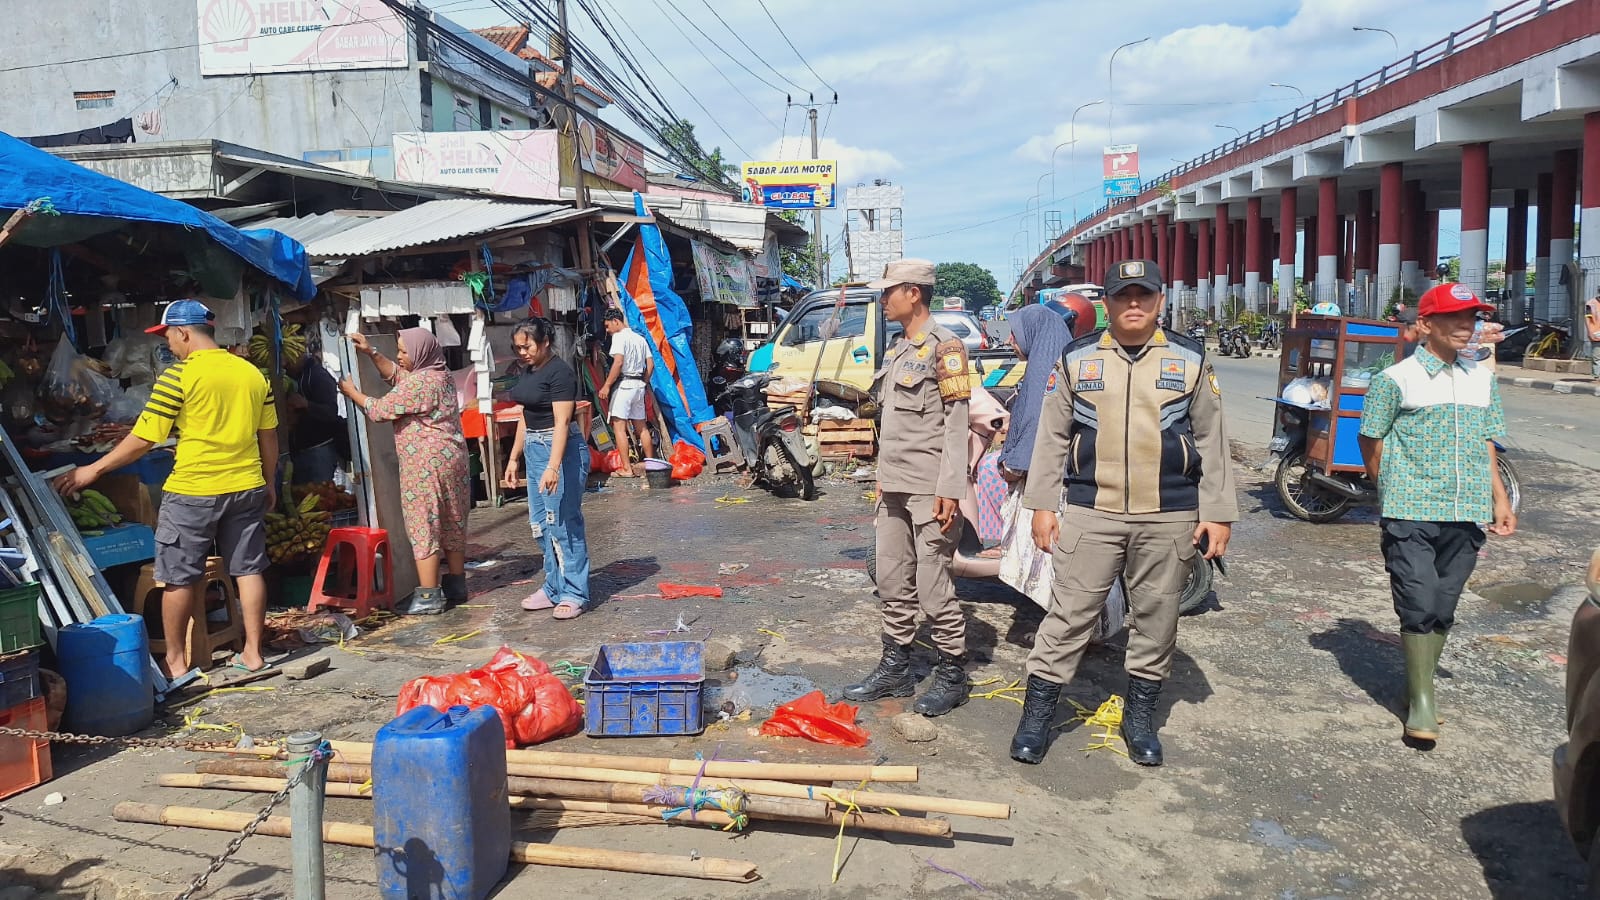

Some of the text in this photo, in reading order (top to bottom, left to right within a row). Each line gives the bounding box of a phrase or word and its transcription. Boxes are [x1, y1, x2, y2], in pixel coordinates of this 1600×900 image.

[260, 24, 322, 34] AUTO CARE CENTRE
[440, 149, 497, 166] HELIX
[440, 167, 456, 175] AUTO
[747, 164, 832, 175] SABAR JAYA MOTOR
